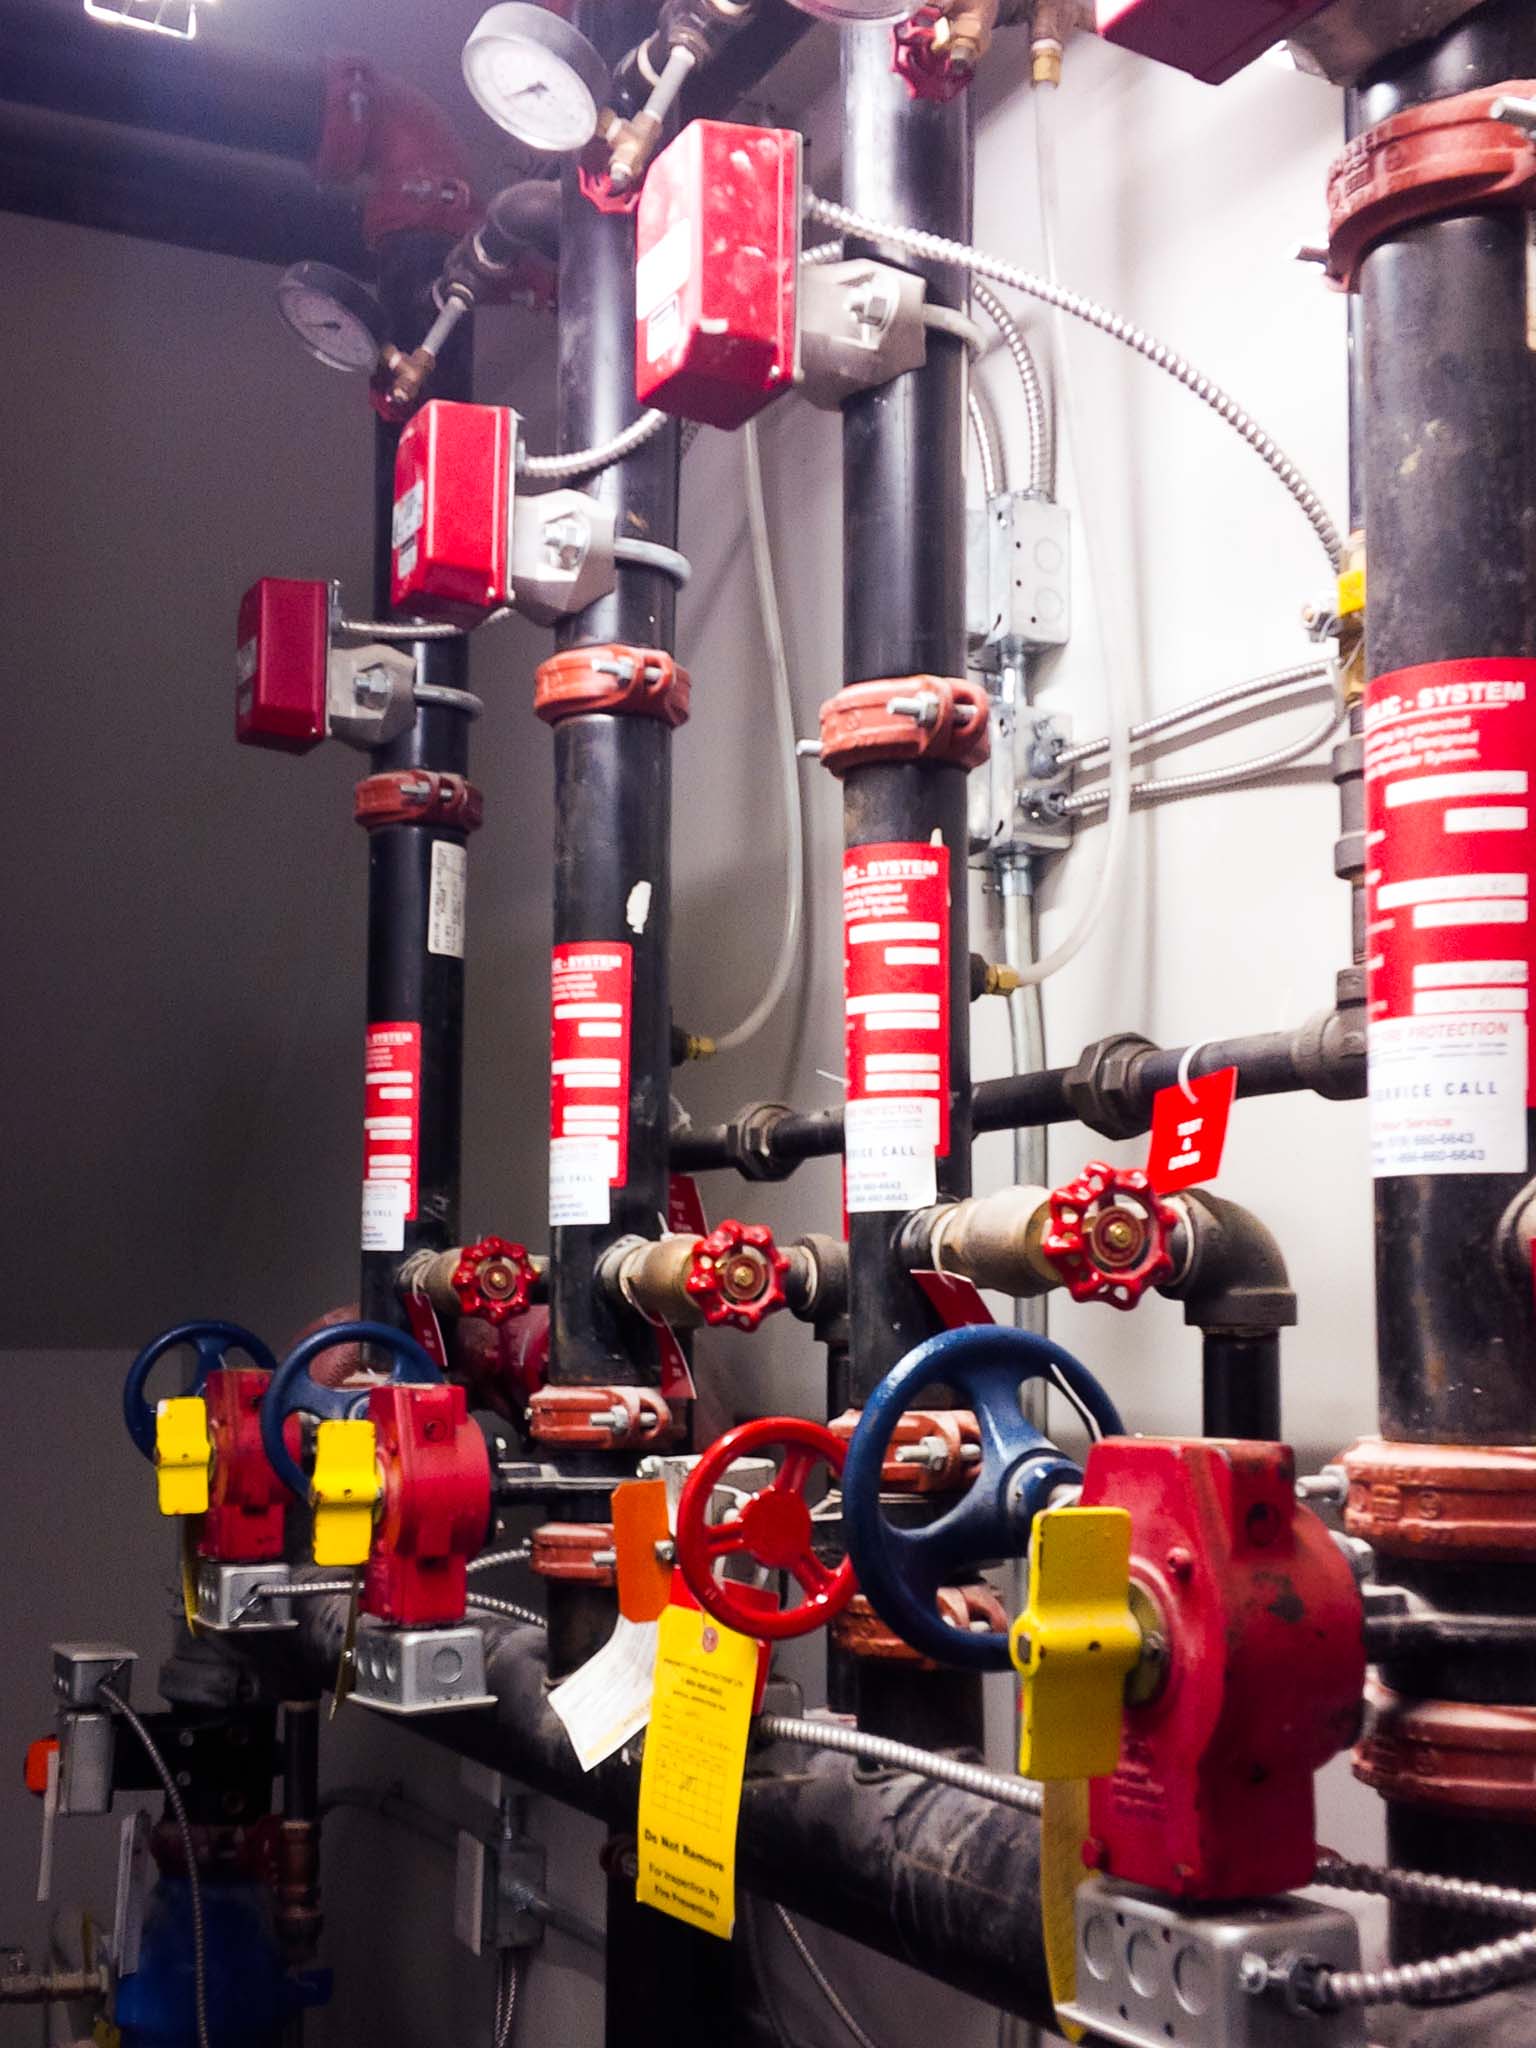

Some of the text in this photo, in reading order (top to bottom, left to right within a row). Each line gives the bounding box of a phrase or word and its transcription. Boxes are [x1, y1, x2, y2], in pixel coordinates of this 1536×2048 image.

[1417, 681, 1526, 710] SYSTEM
[867, 859, 939, 876] SYSTEM
[1444, 1080, 1499, 1097] CALL
[881, 1145, 918, 1158] CALL
